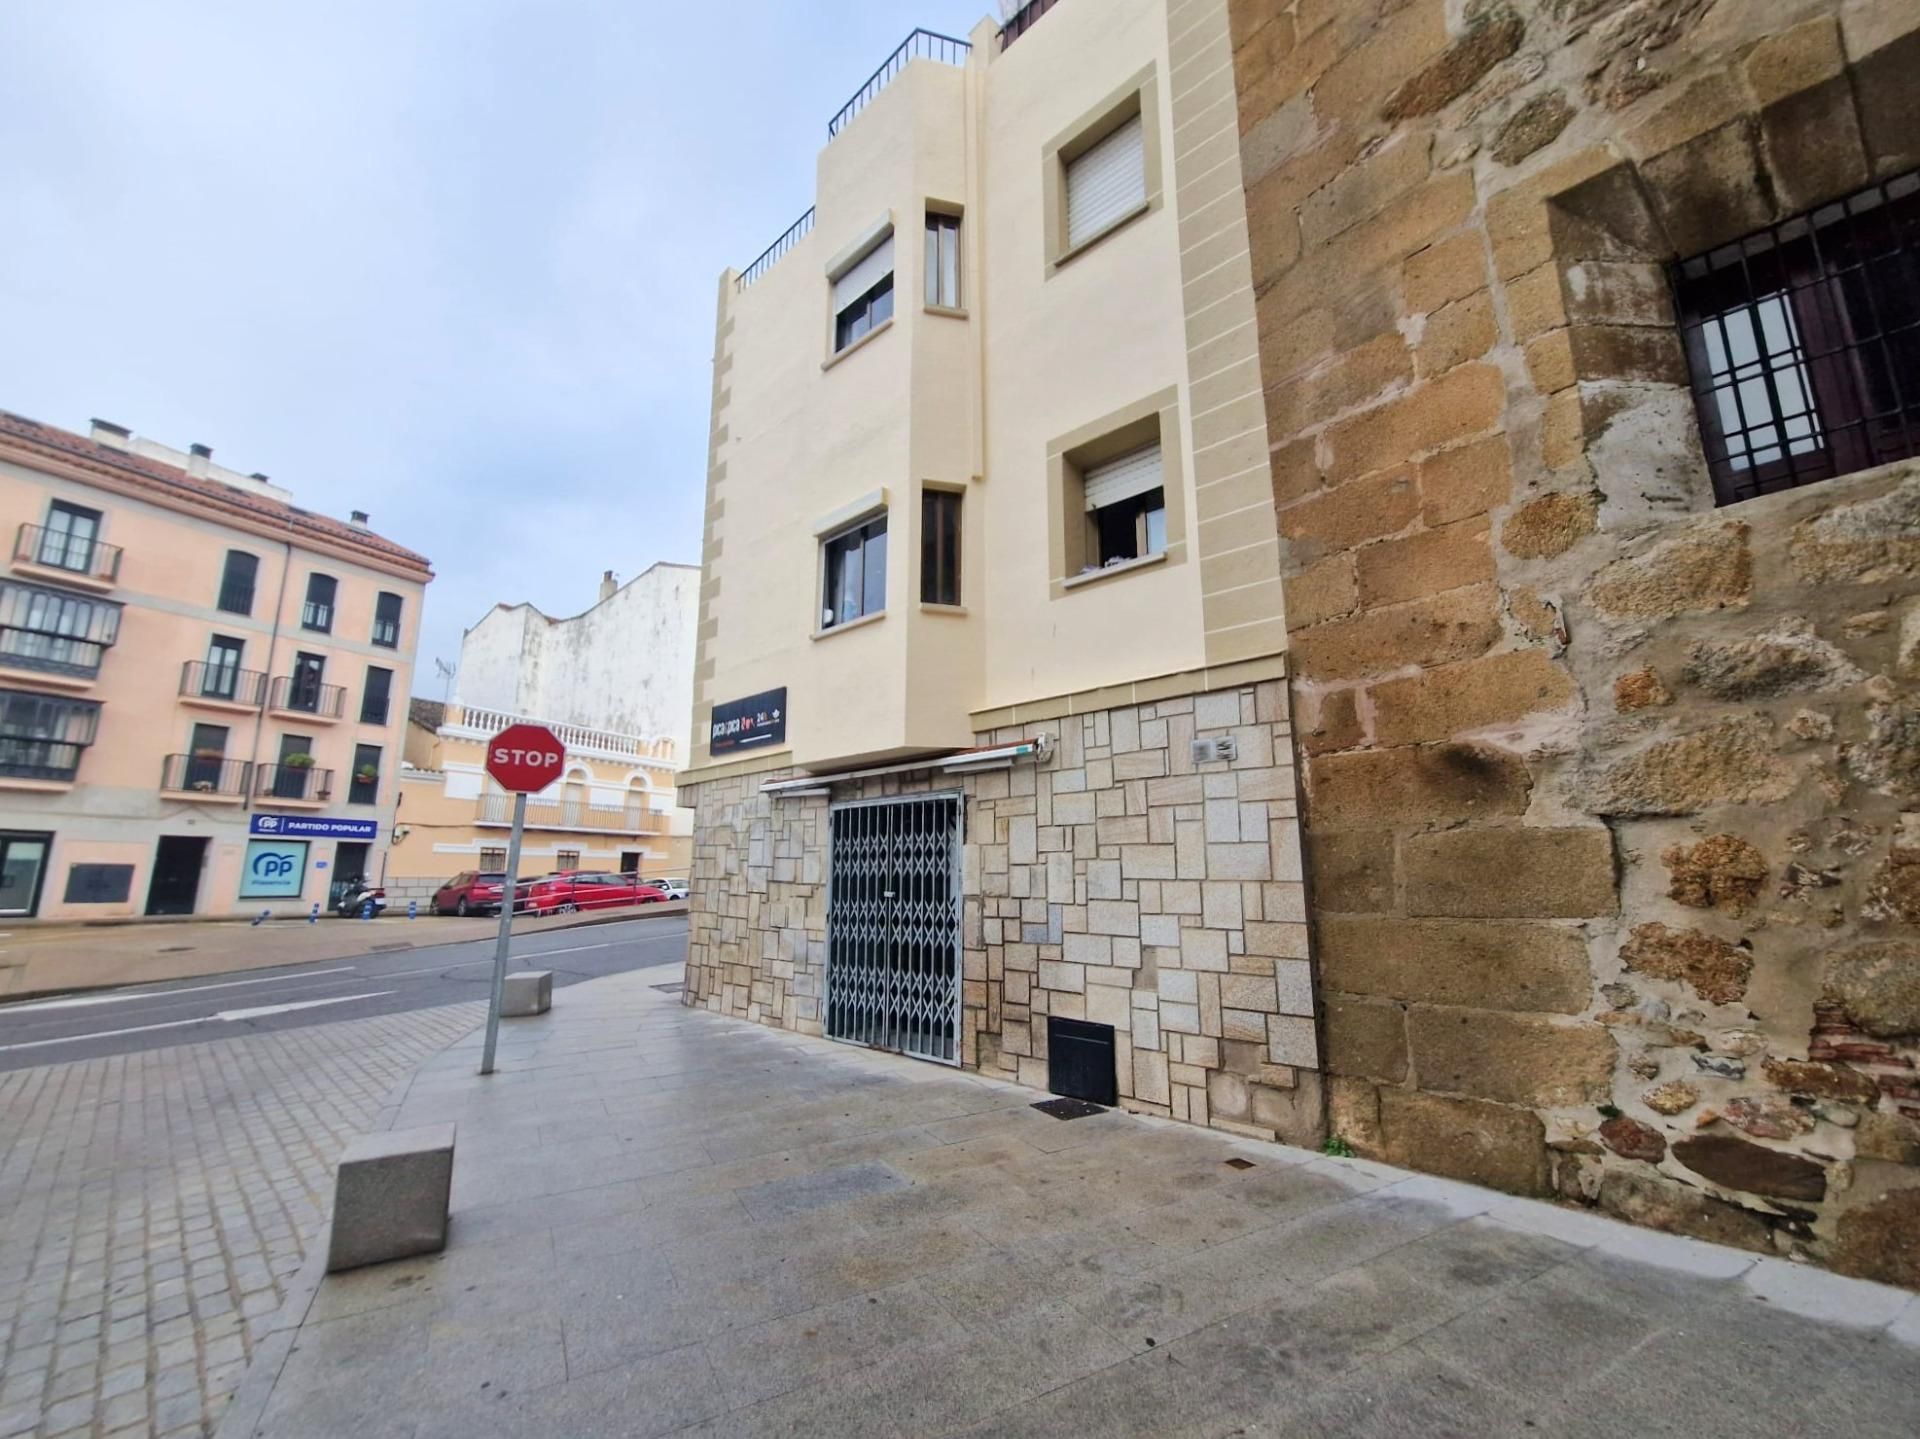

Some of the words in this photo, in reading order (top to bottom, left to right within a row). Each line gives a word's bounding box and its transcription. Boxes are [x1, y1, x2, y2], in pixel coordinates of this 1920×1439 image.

[494, 748, 559, 768] STOP
[288, 822, 329, 831] PARTIDO
[331, 824, 371, 832] POPULAR
